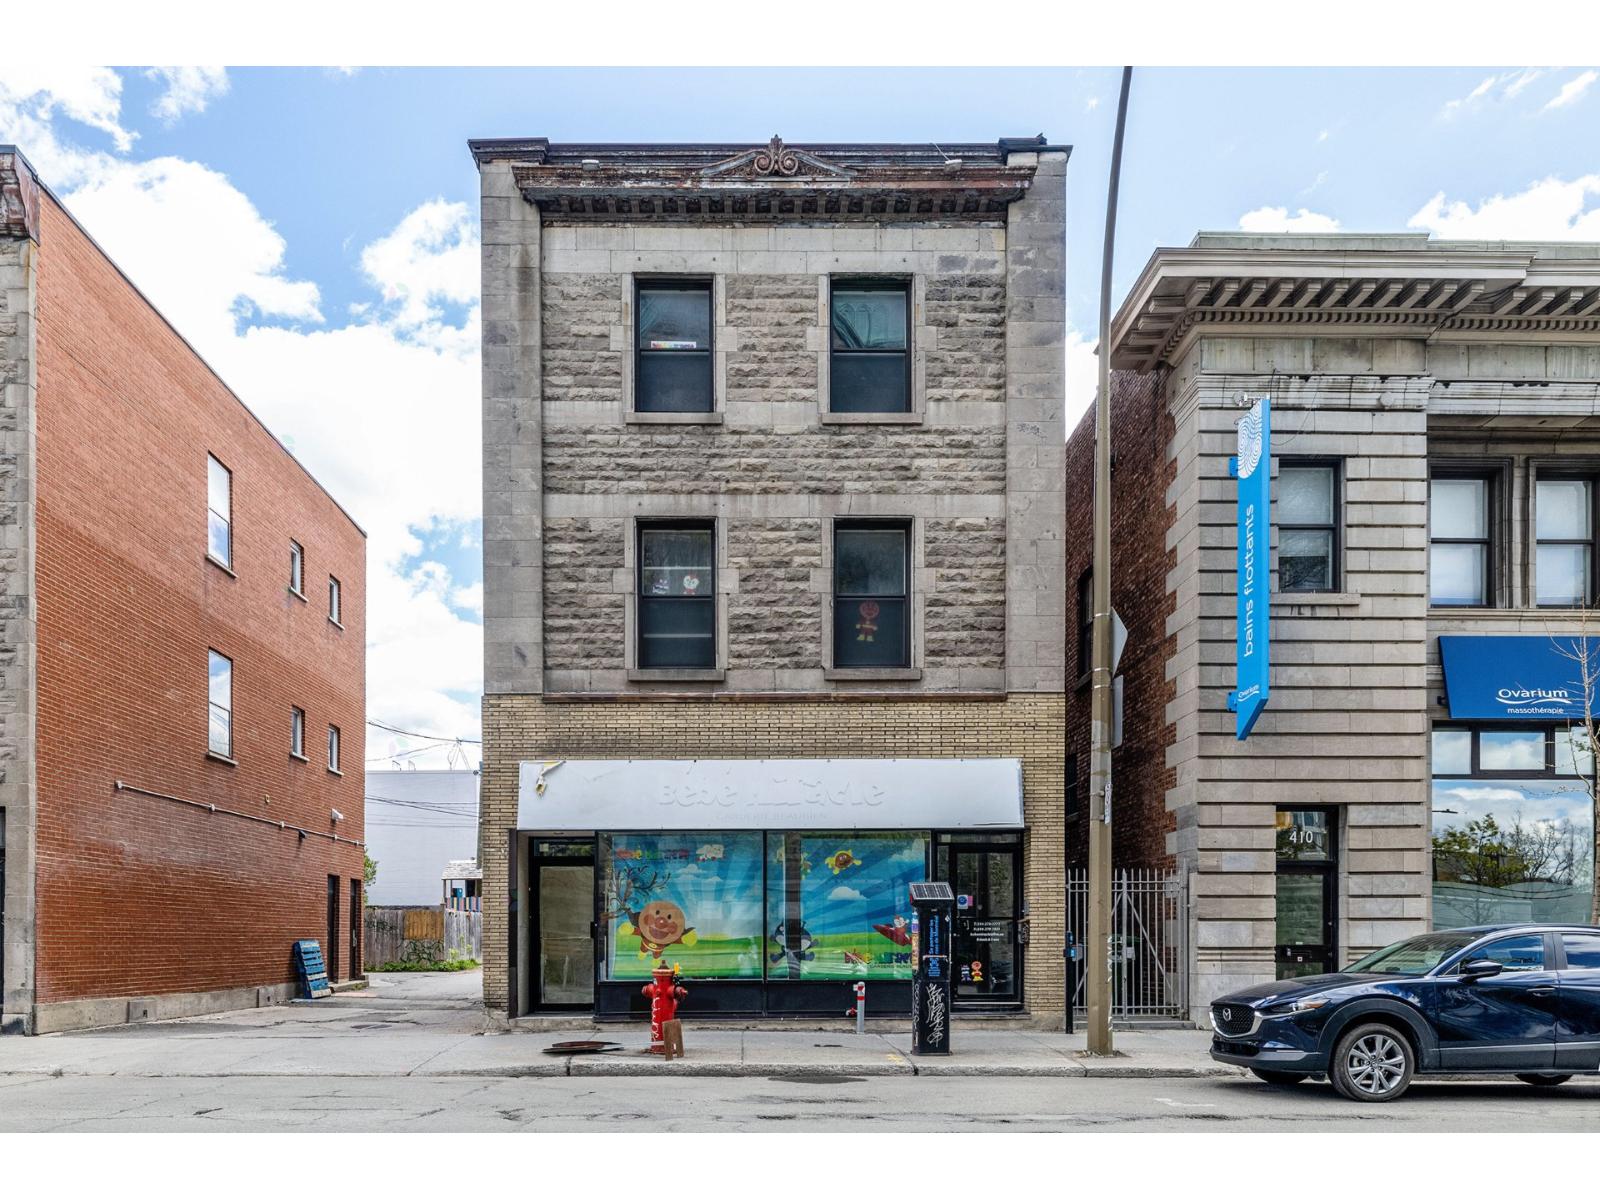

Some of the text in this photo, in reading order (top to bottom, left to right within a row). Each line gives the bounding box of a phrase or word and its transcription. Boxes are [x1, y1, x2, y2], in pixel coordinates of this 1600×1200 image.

[1244, 504, 1254, 657] bains flottants
[1498, 688, 1569, 698] Ovarium
[1507, 707, 1565, 715] massothérapie
[1289, 830, 1314, 844] 410
